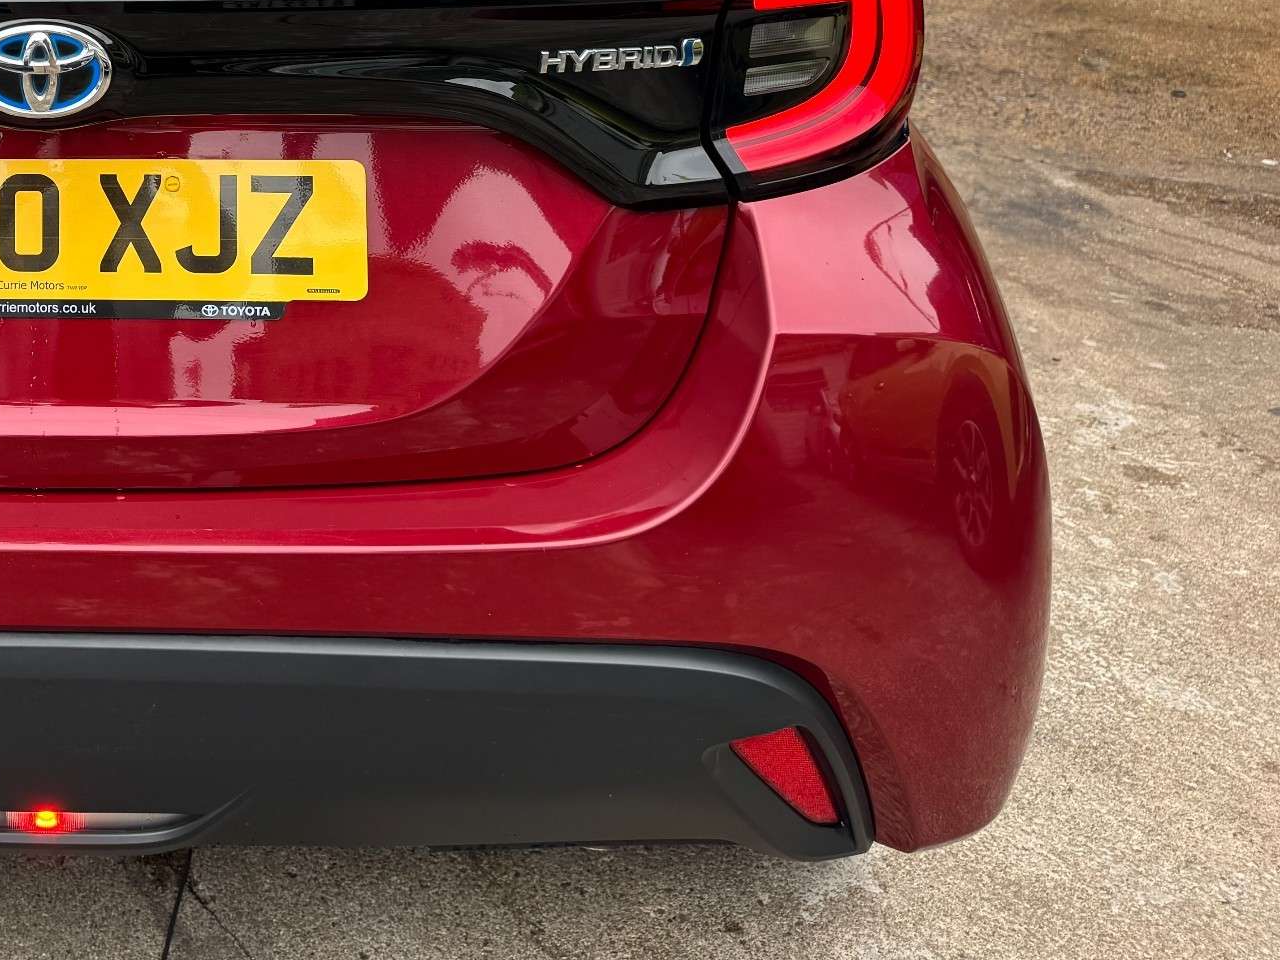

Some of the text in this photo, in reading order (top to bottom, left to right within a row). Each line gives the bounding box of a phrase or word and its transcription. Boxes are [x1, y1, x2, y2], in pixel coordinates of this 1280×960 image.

[539, 45, 678, 74] HYBRID
[99, 173, 314, 275] XJZ
[30, 280, 64, 290] Motors
[220, 306, 271, 317] TOYOTA
